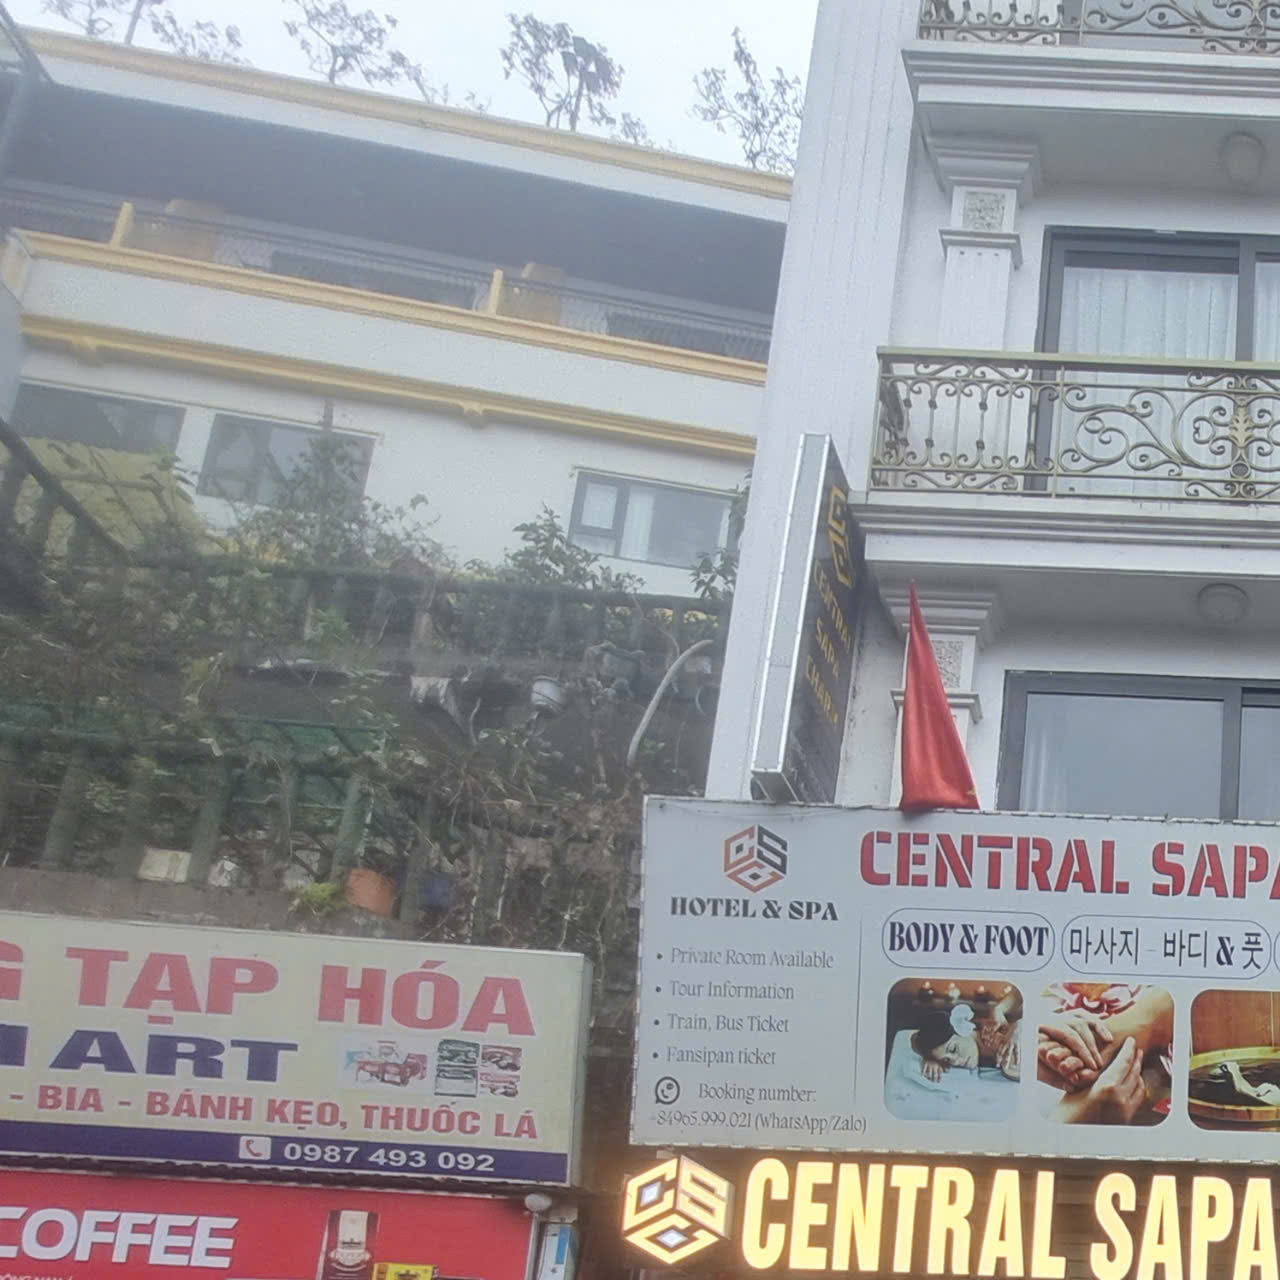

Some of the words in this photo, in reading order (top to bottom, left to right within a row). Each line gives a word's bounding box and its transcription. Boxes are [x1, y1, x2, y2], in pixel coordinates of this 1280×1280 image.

[860, 830, 1130, 895] CENTRAL
[670, 897, 757, 920] HOTEL
[762, 901, 782, 920] &
[788, 900, 839, 922] SPA
[889, 920, 954, 955] BODY
[959, 925, 978, 955] &
[985, 925, 1049, 957] FOOT
[1069, 926, 1141, 967] 마사지
[1162, 929, 1208, 969] 바디
[1216, 937, 1235, 966] &
[1241, 931, 1264, 970] 풋
[671, 947, 722, 966] Private
[726, 949, 766, 966] Room
[769, 950, 834, 969] Available
[66, 946, 279, 1025] TẠP
[317, 960, 536, 1038] HÓA
[670, 980, 703, 997] Tour
[708, 980, 795, 1000] Information
[668, 1013, 712, 1032] Train,
[716, 1014, 744, 1031] Bus
[747, 1015, 789, 1033] Ticket
[666, 1046, 734, 1068] Fansipan
[738, 1047, 776, 1065] ticket
[699, 1083, 754, 1105] Booking
[759, 1085, 817, 1102] number:
[37, 1083, 104, 1114] BIA
[146, 1087, 252, 1122] BÁNH
[266, 1092, 348, 1131] KẸO,
[361, 1101, 481, 1136] THUỐC
[494, 1108, 538, 1140] LÁ
[284, 1142, 359, 1165] 0987
[368, 1146, 427, 1170] 493
[437, 1150, 496, 1173] 092
[741, 1156, 1067, 1280] CENTRAL
